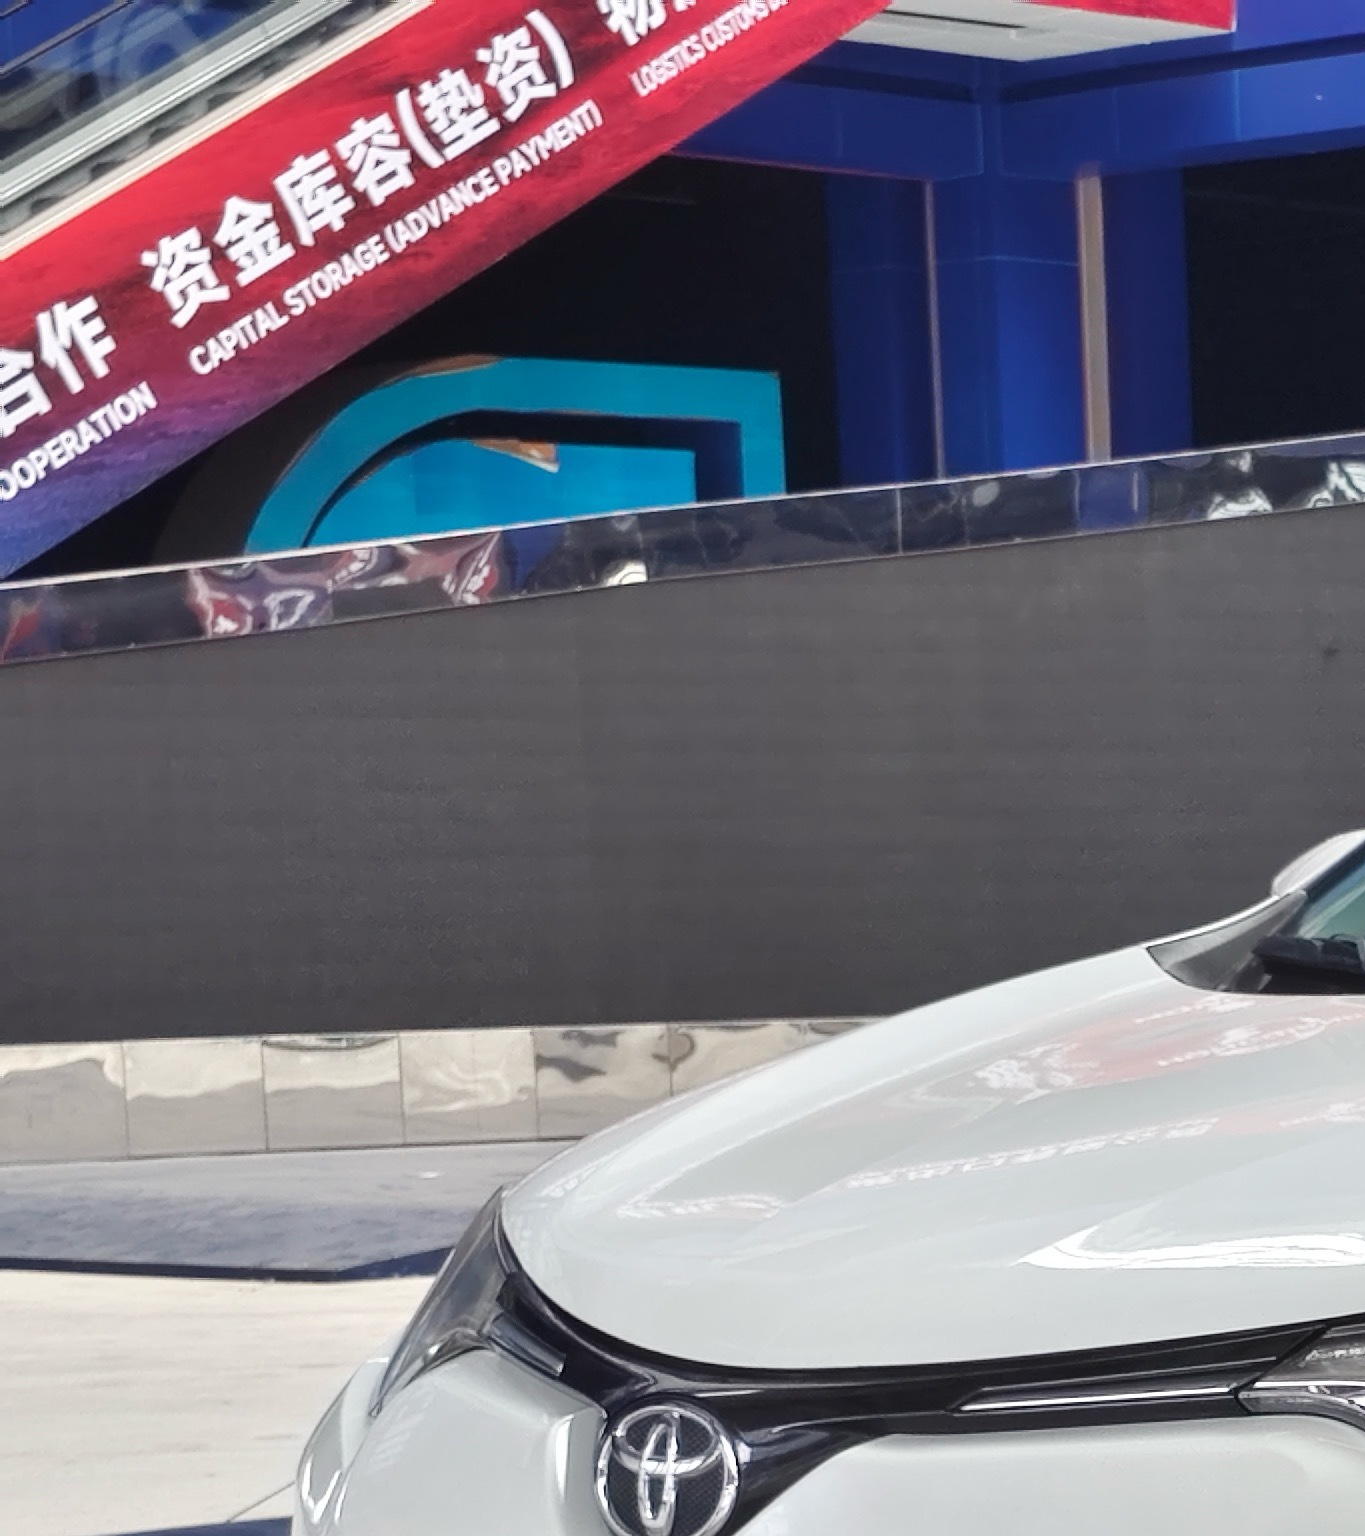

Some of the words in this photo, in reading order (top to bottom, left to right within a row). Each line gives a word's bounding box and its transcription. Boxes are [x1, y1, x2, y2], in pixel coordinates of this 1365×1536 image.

[0, 295, 117, 437] 合作
[140, 9, 575, 329] 资金库容(垫资)
[188, 300, 291, 375] CAPITAL
[282, 234, 391, 316] STORAGE
[384, 167, 501, 253] (ADVANCE
[492, 98, 604, 187] PAYMENT)
[628, 33, 707, 97] LOGISTICS
